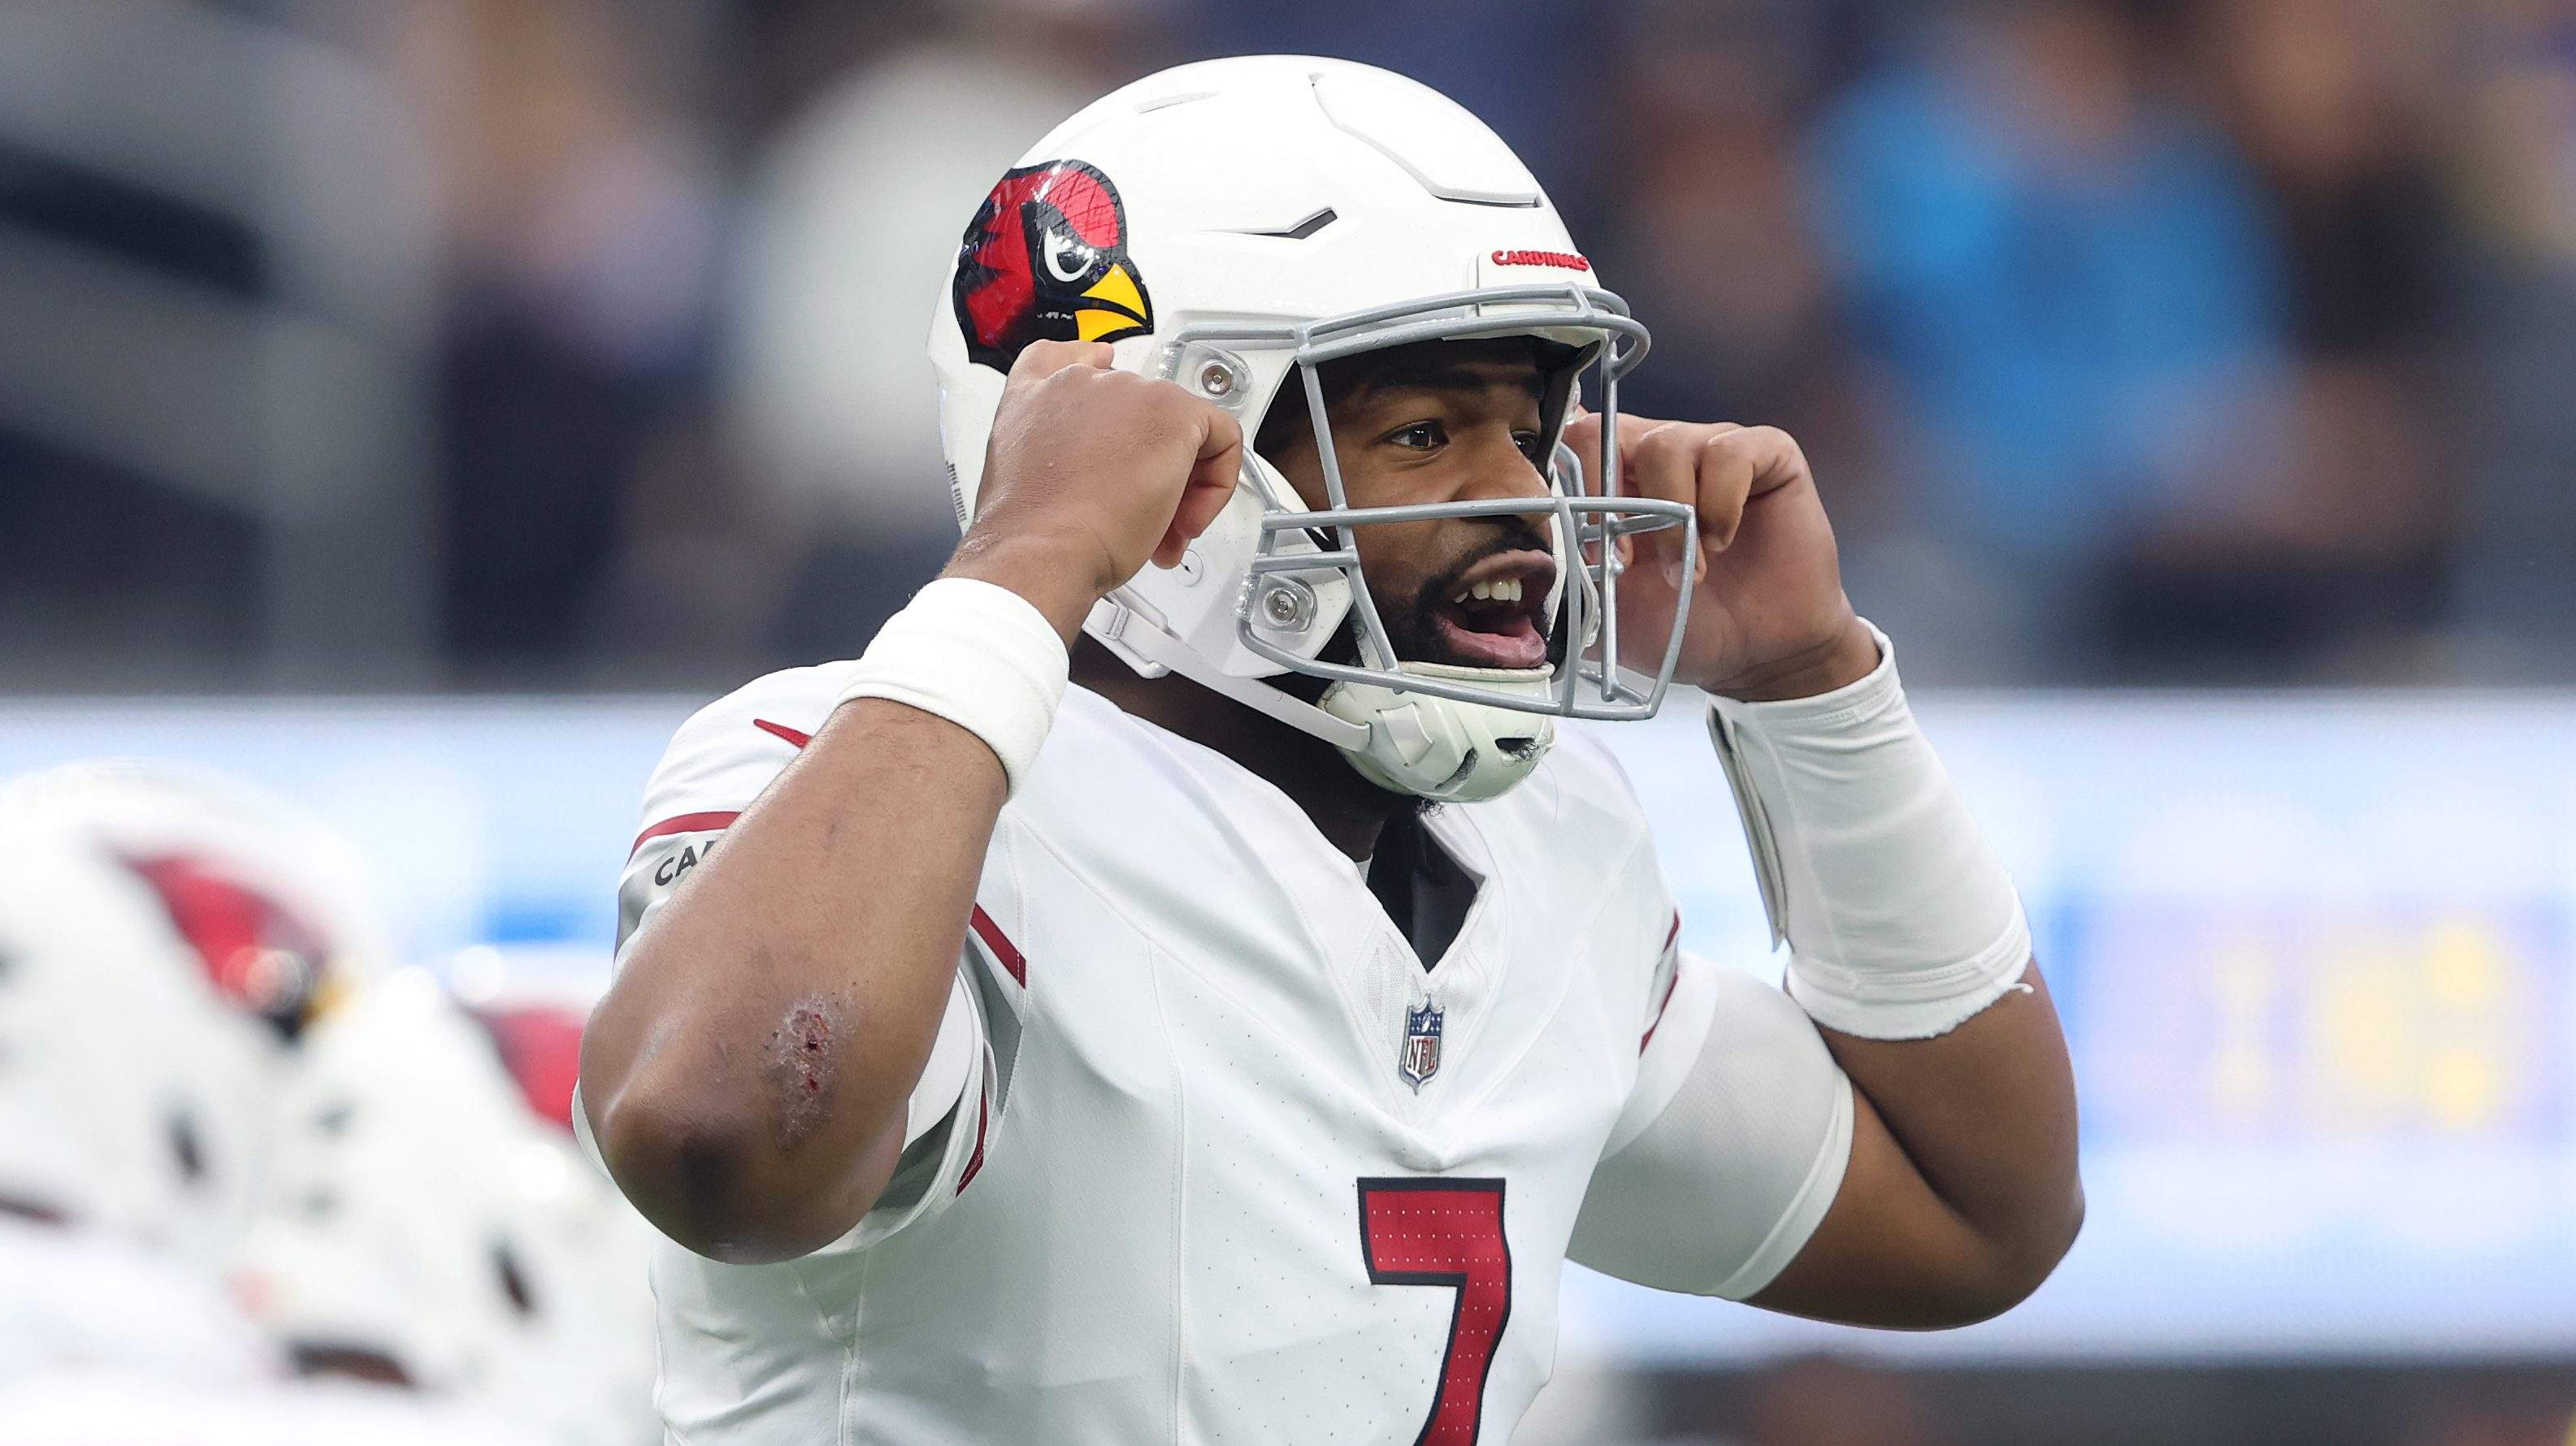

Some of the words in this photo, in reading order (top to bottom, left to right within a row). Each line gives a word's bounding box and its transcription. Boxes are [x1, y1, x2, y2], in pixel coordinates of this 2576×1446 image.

[1491, 250, 1589, 272] CARDINALS
[654, 840, 718, 886] CA
[1407, 1038, 1436, 1074] NFL
[1356, 1176, 1511, 1446] 7
